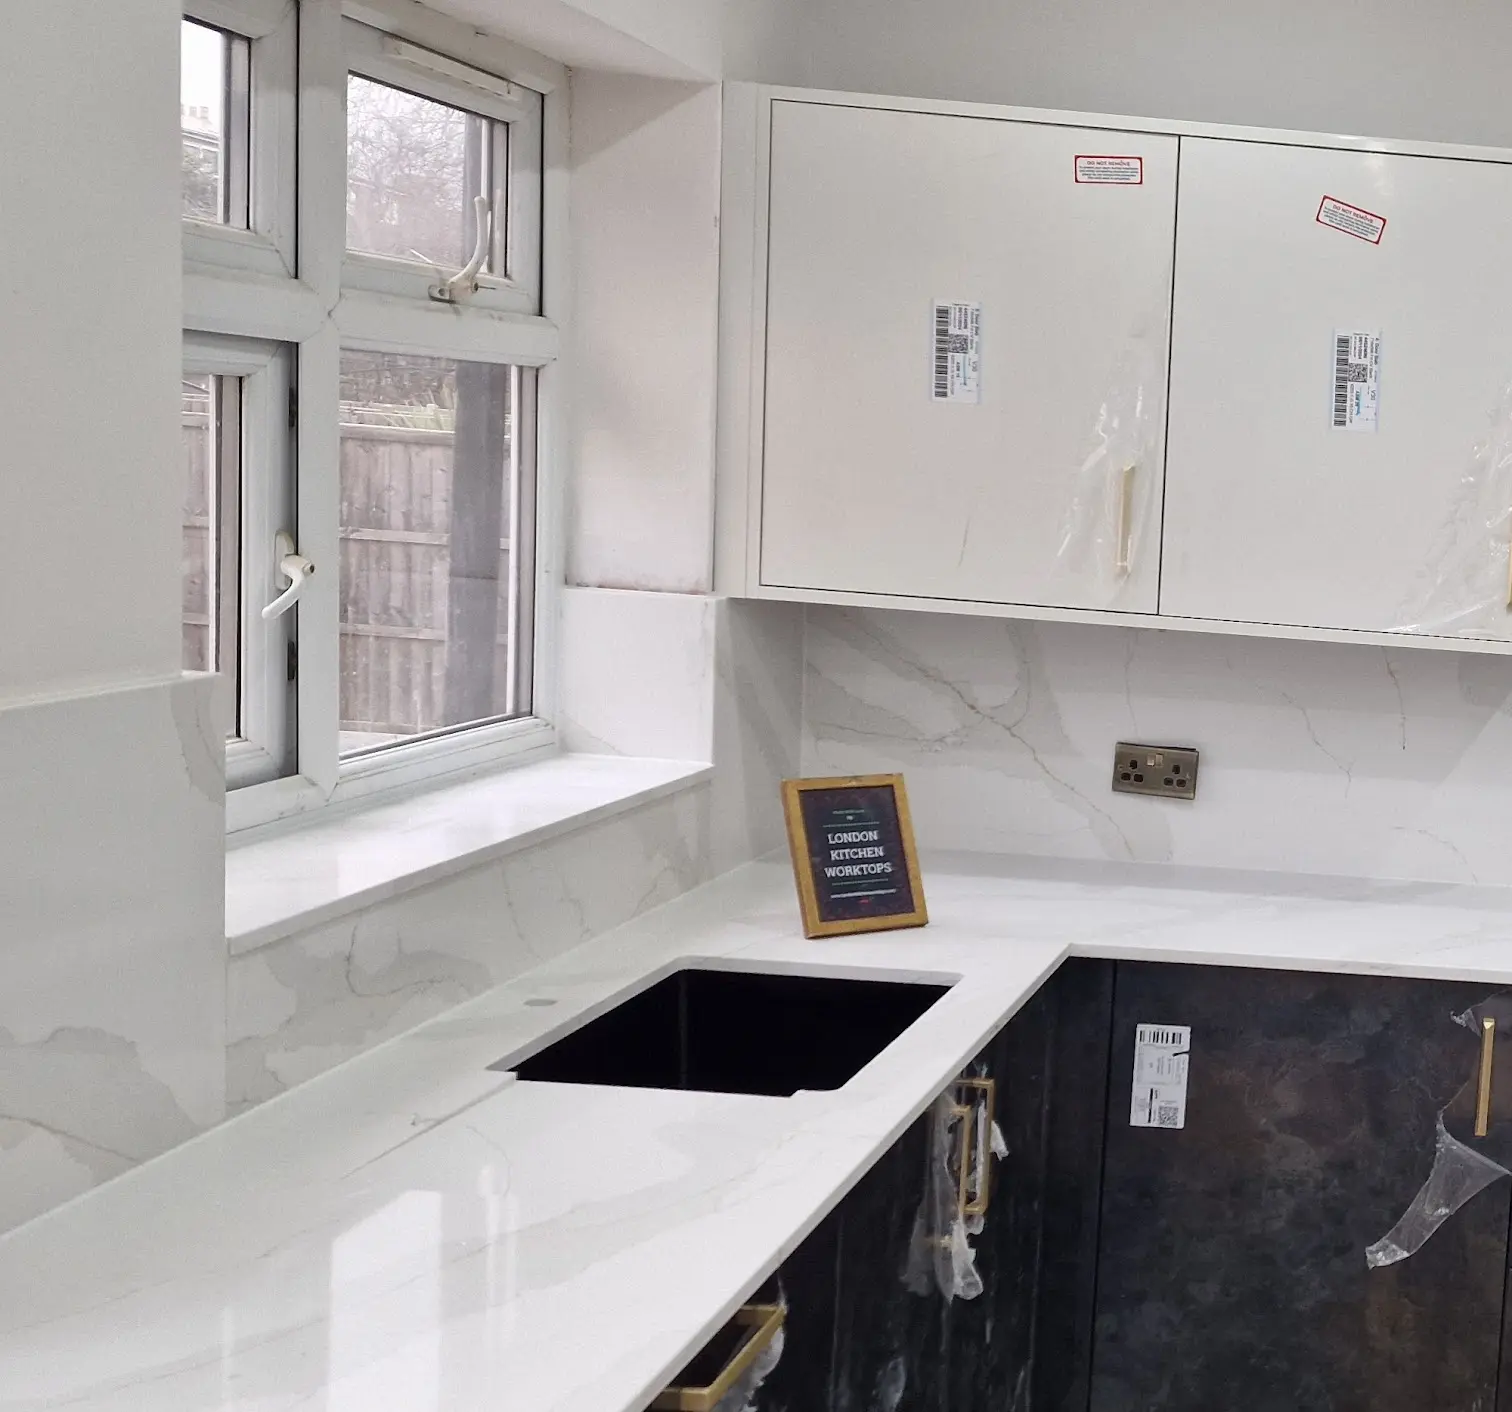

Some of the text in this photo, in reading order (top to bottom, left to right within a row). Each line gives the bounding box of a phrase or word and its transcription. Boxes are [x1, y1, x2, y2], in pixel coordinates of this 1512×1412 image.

[827, 830, 879, 845] LONDON
[830, 846, 885, 861] KITCHEN
[824, 862, 893, 878] WORKTOPS
